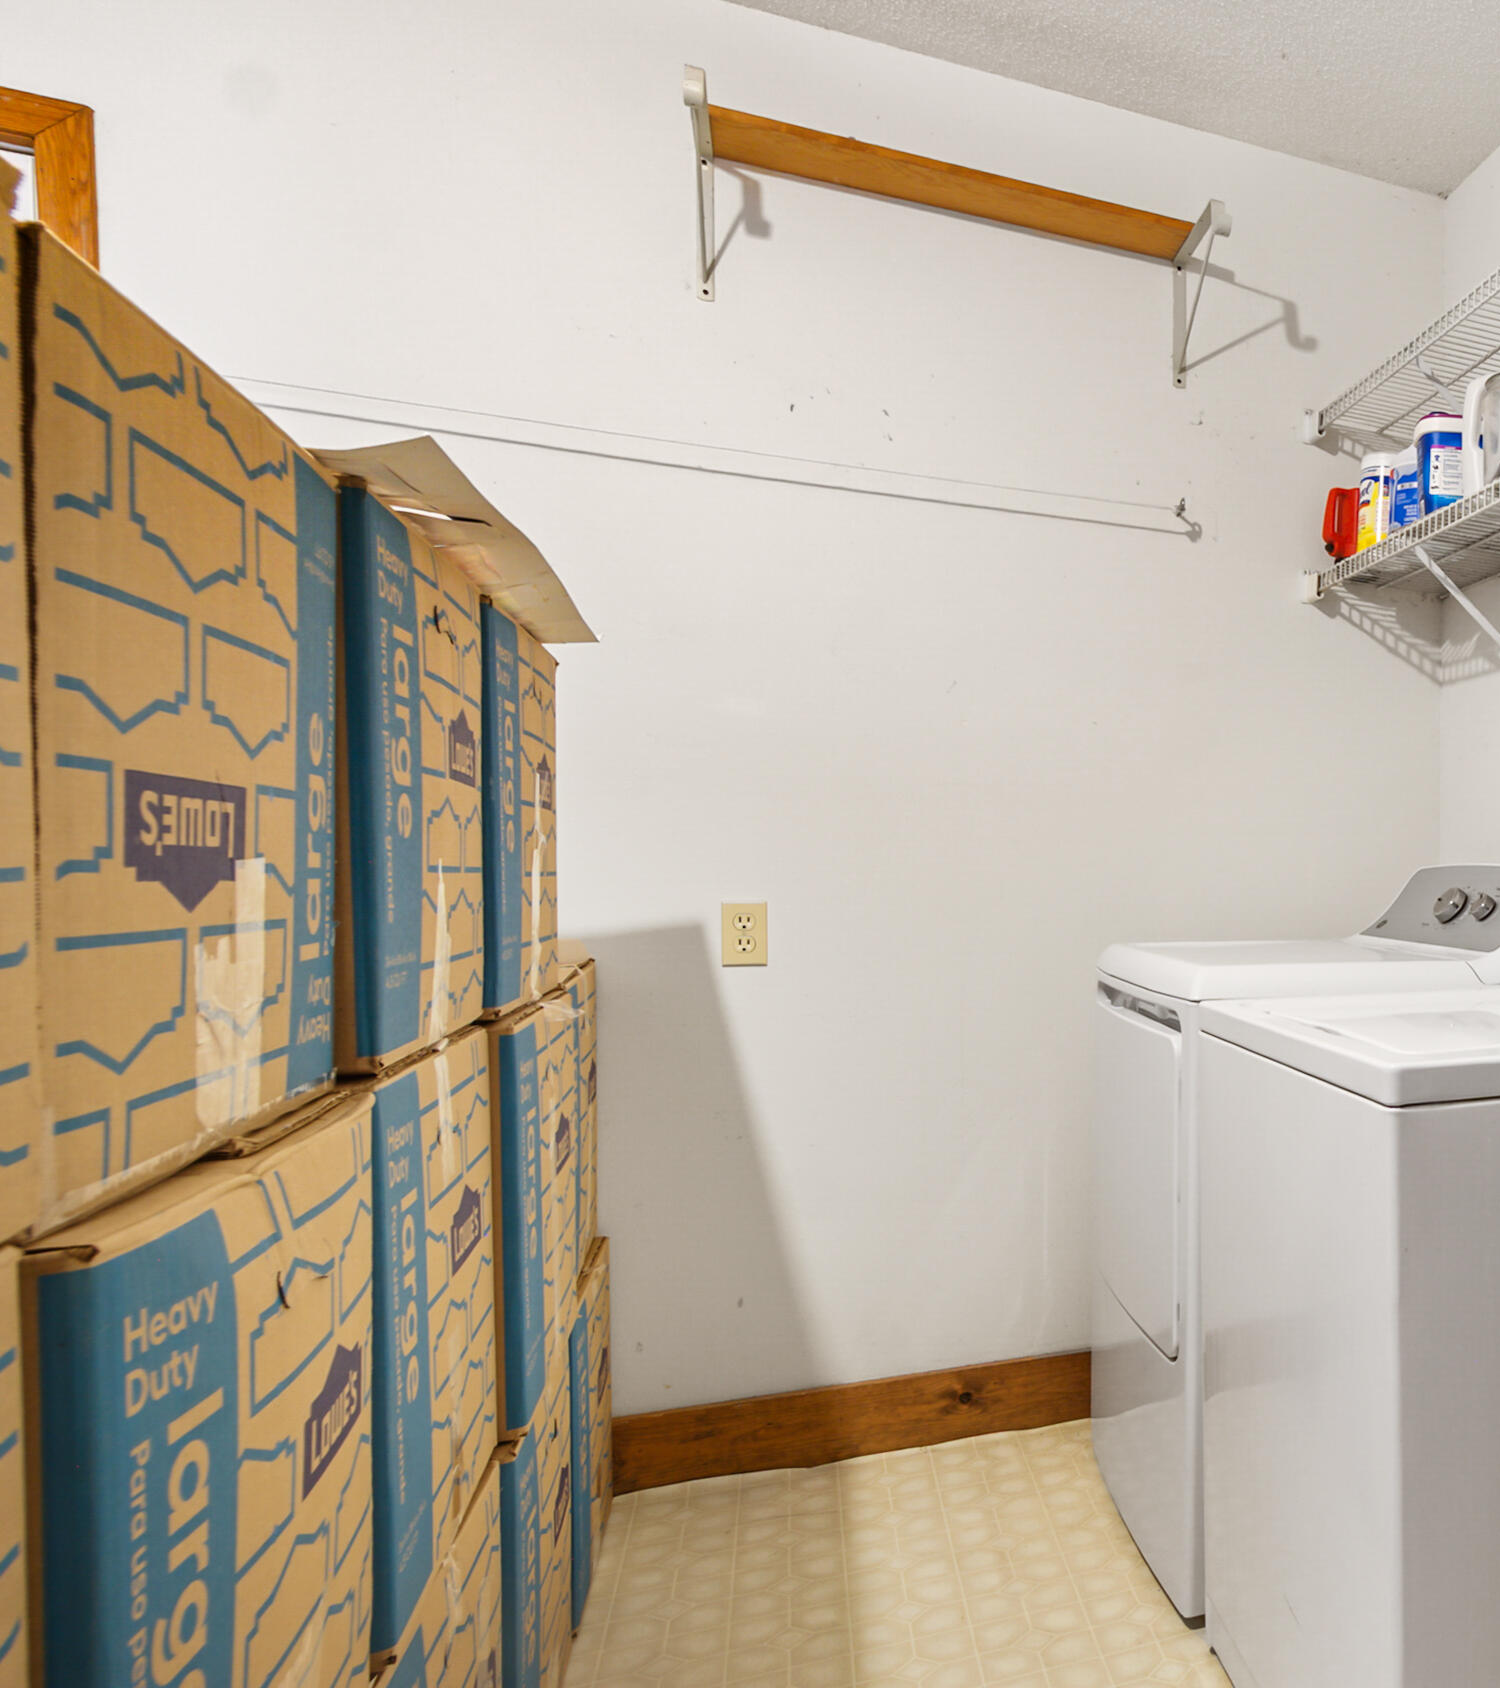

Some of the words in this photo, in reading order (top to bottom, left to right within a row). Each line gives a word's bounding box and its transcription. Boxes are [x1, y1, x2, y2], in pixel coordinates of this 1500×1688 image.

[376, 535, 408, 586] Heavy
[377, 570, 403, 614] Duty
[390, 624, 414, 839] large
[504, 699, 516, 853] large
[139, 790, 236, 858] LOWE'S
[299, 712, 326, 962] large
[307, 974, 331, 1006] Duty
[297, 1012, 331, 1045] Heavy
[387, 1120, 414, 1155] Heavy
[389, 1156, 409, 1189] Duty
[526, 1106, 537, 1259] large
[123, 1281, 218, 1363] Heavy
[400, 1187, 419, 1404] large
[125, 1345, 199, 1418] Duty
[130, 1546, 149, 1620] uso
